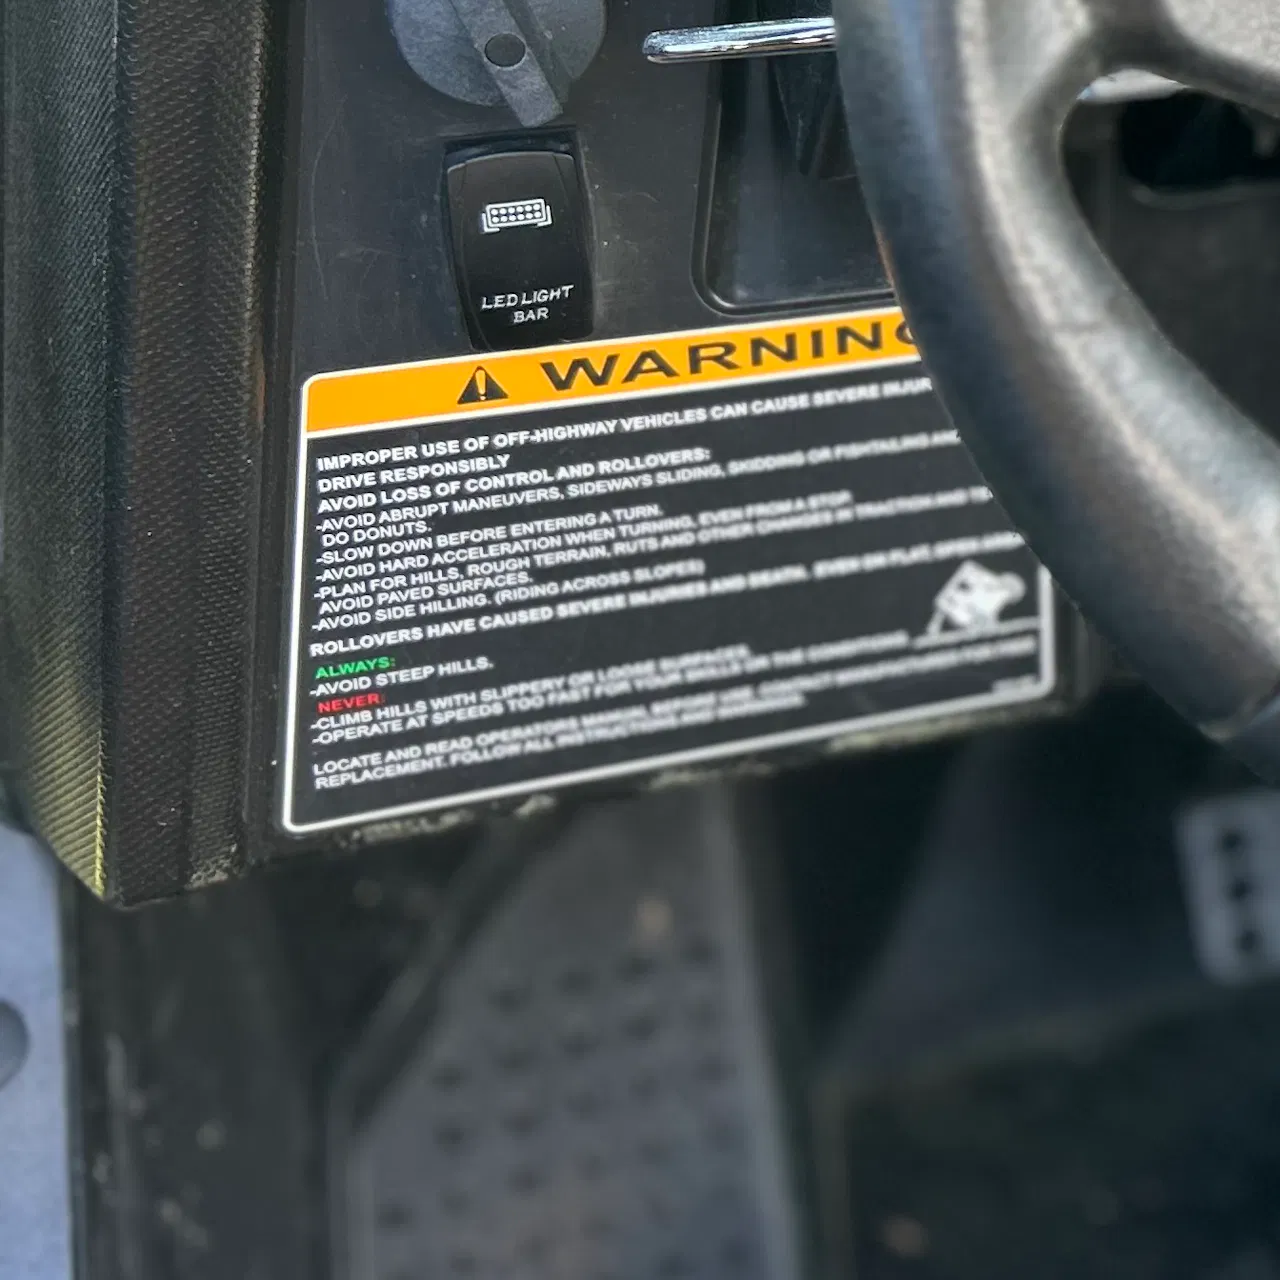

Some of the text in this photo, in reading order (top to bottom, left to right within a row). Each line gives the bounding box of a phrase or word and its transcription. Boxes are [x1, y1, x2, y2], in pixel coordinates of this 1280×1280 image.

[481, 284, 575, 310] LED LIGHT
[513, 307, 549, 324] BAR
[316, 376, 932, 472] IMPROPER USE OF OFF-HIGHWAY VEHICLES CAN CAUSE SEVERE INJUR
[316, 512, 375, 533] -AVOID
[379, 501, 448, 524] ABRUPT
[453, 484, 564, 514] MANEUVERS,
[568, 472, 652, 498] SIDEWAYS
[656, 462, 725, 486] SLIDING,
[317, 452, 510, 493] DRIVE RESPONSIBLY
[317, 444, 710, 514] AVOID LOSS OF CONTROL AND ROLLOVERS:
[316, 501, 662, 565] -SLOW DOWN BEFORE ENTERING A TURN.
[316, 562, 375, 583] -AVOID
[380, 554, 428, 573] HARD
[432, 533, 560, 567] ACCELERATION
[564, 526, 614, 547] WHEN
[323, 518, 432, 547] DO DONUTS.
[314, 580, 365, 600] -PLAN
[370, 574, 406, 592] FOR
[410, 565, 463, 586] HILLS,
[468, 555, 528, 577] ROUGH
[533, 542, 610, 569] TERRAIN,
[613, 535, 658, 556] RUTS
[660, 530, 695, 549] AND
[319, 569, 533, 615] AVOID PAVED SURFACES.
[309, 626, 422, 658] ROLLOVERS
[427, 617, 475, 639] HAVE
[479, 604, 552, 631] CAUSED
[556, 592, 626, 619] SEVERE
[312, 610, 370, 632] -AVOID
[375, 603, 415, 622] SIDE
[420, 591, 490, 616] HILLING.
[495, 580, 558, 604] (RIDING
[562, 569, 630, 594] ACROSS
[309, 655, 493, 698] -AVOID STEEP HILLS.
[315, 654, 395, 679] ALWAYS:
[310, 709, 373, 732] -CLIMB
[377, 699, 427, 721] HILLS
[430, 691, 476, 712] WITH
[480, 675, 565, 703] SLIPPERY
[312, 718, 403, 746] -OPERATE
[405, 713, 427, 730] AT
[431, 699, 502, 726] SPEEDS
[507, 692, 545, 713] TOO
[547, 684, 589, 706] FAST
[317, 691, 385, 713] NEVER:
[313, 751, 381, 776] LOCATE
[384, 744, 420, 764] AND
[425, 735, 471, 757] READ
